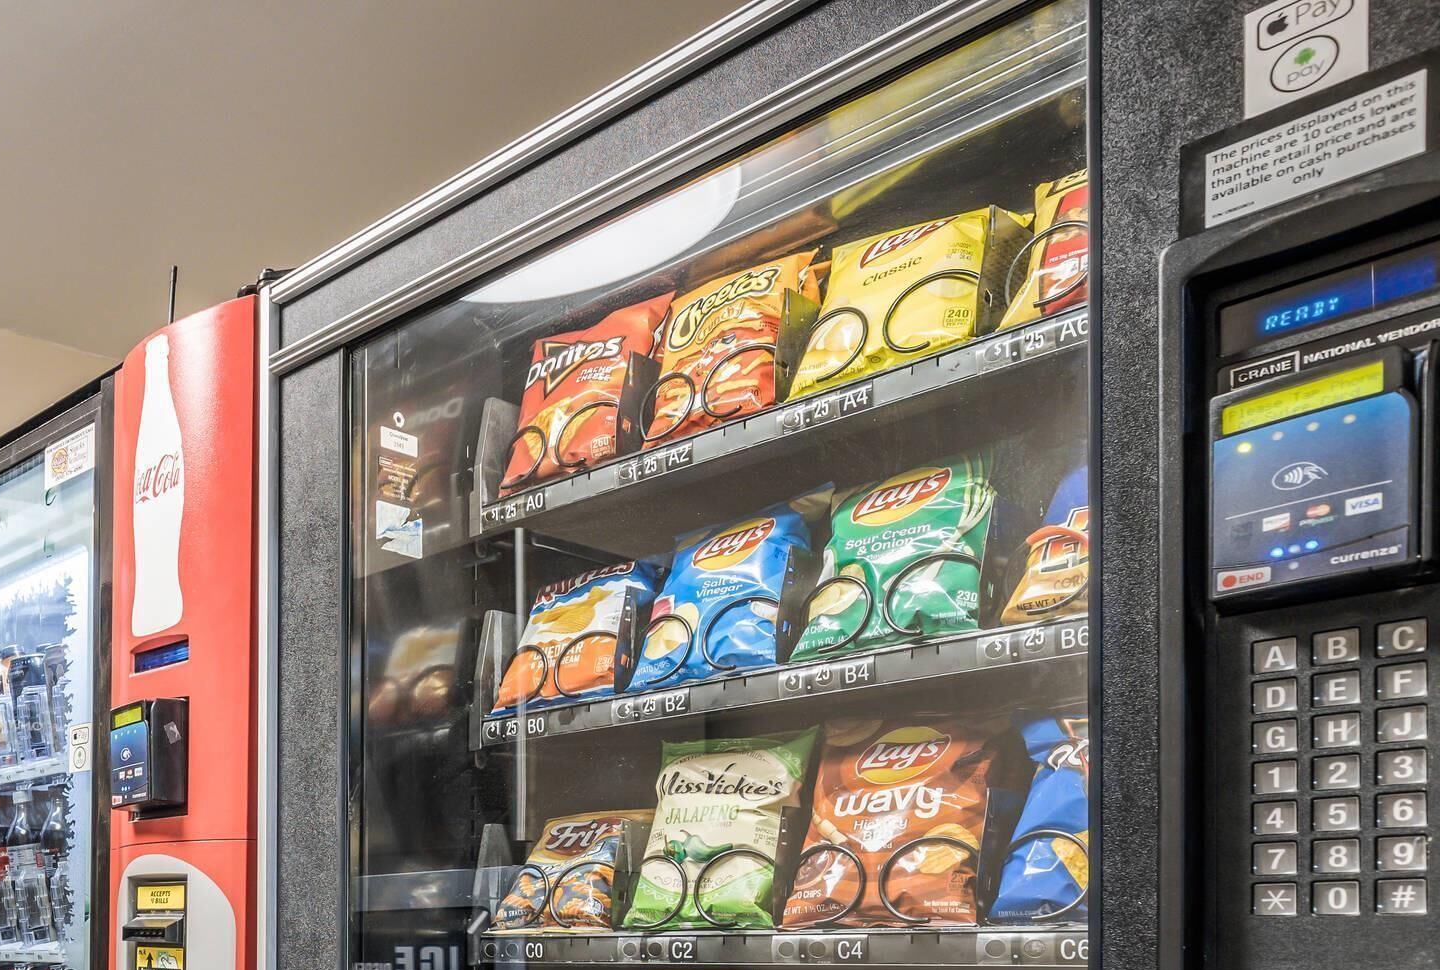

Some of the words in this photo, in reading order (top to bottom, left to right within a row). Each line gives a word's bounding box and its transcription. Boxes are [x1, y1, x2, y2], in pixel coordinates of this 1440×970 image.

[1295, 0, 1341, 26] Pay
[1287, 59, 1326, 86] pay
[1212, 151, 1239, 165] The
[1242, 130, 1282, 156] prices
[1287, 102, 1356, 136] displayed
[1361, 93, 1382, 108] on
[1386, 80, 1416, 99] this
[1212, 150, 1270, 176] machine
[1274, 140, 1297, 156] are
[1303, 128, 1320, 142] 10
[1325, 111, 1365, 136] cents
[1370, 94, 1416, 118] lower
[1211, 172, 1241, 190] than
[1246, 161, 1268, 177] the
[1272, 144, 1309, 167] retail
[1314, 131, 1352, 156] price
[1357, 118, 1386, 138] and
[1390, 107, 1416, 123] are
[1212, 173, 1272, 201] available
[1276, 165, 1294, 178] on
[1299, 151, 1332, 171] cash
[1336, 121, 1416, 159] purchases
[1292, 166, 1324, 186] only
[666, 264, 784, 352] Cheetos
[948, 309, 969, 319] 240
[1265, 298, 1339, 331] READY
[525, 335, 625, 391] Doritos
[1238, 360, 1292, 383] CRANE
[1304, 338, 1376, 364] NATIONAL
[843, 389, 868, 411] A4
[668, 448, 689, 467] A2
[136, 451, 180, 504] ca-Cola
[526, 492, 544, 512] A0
[1350, 497, 1380, 510] VISA
[845, 535, 879, 550] Sour
[881, 523, 931, 545] Cream
[1330, 545, 1399, 564] currenza
[703, 578, 727, 588] Salt
[1239, 572, 1264, 584] END
[696, 584, 743, 598] Vinegar
[956, 590, 978, 602] 230
[1328, 637, 1347, 660] B
[1393, 627, 1414, 650] C
[1264, 646, 1285, 669] A
[844, 665, 869, 684] B4
[665, 695, 686, 713] B2
[528, 717, 544, 733] B0
[834, 785, 944, 819] wavy
[546, 819, 622, 851] Frit
[672, 942, 693, 959] C2
[837, 941, 863, 959] C4
